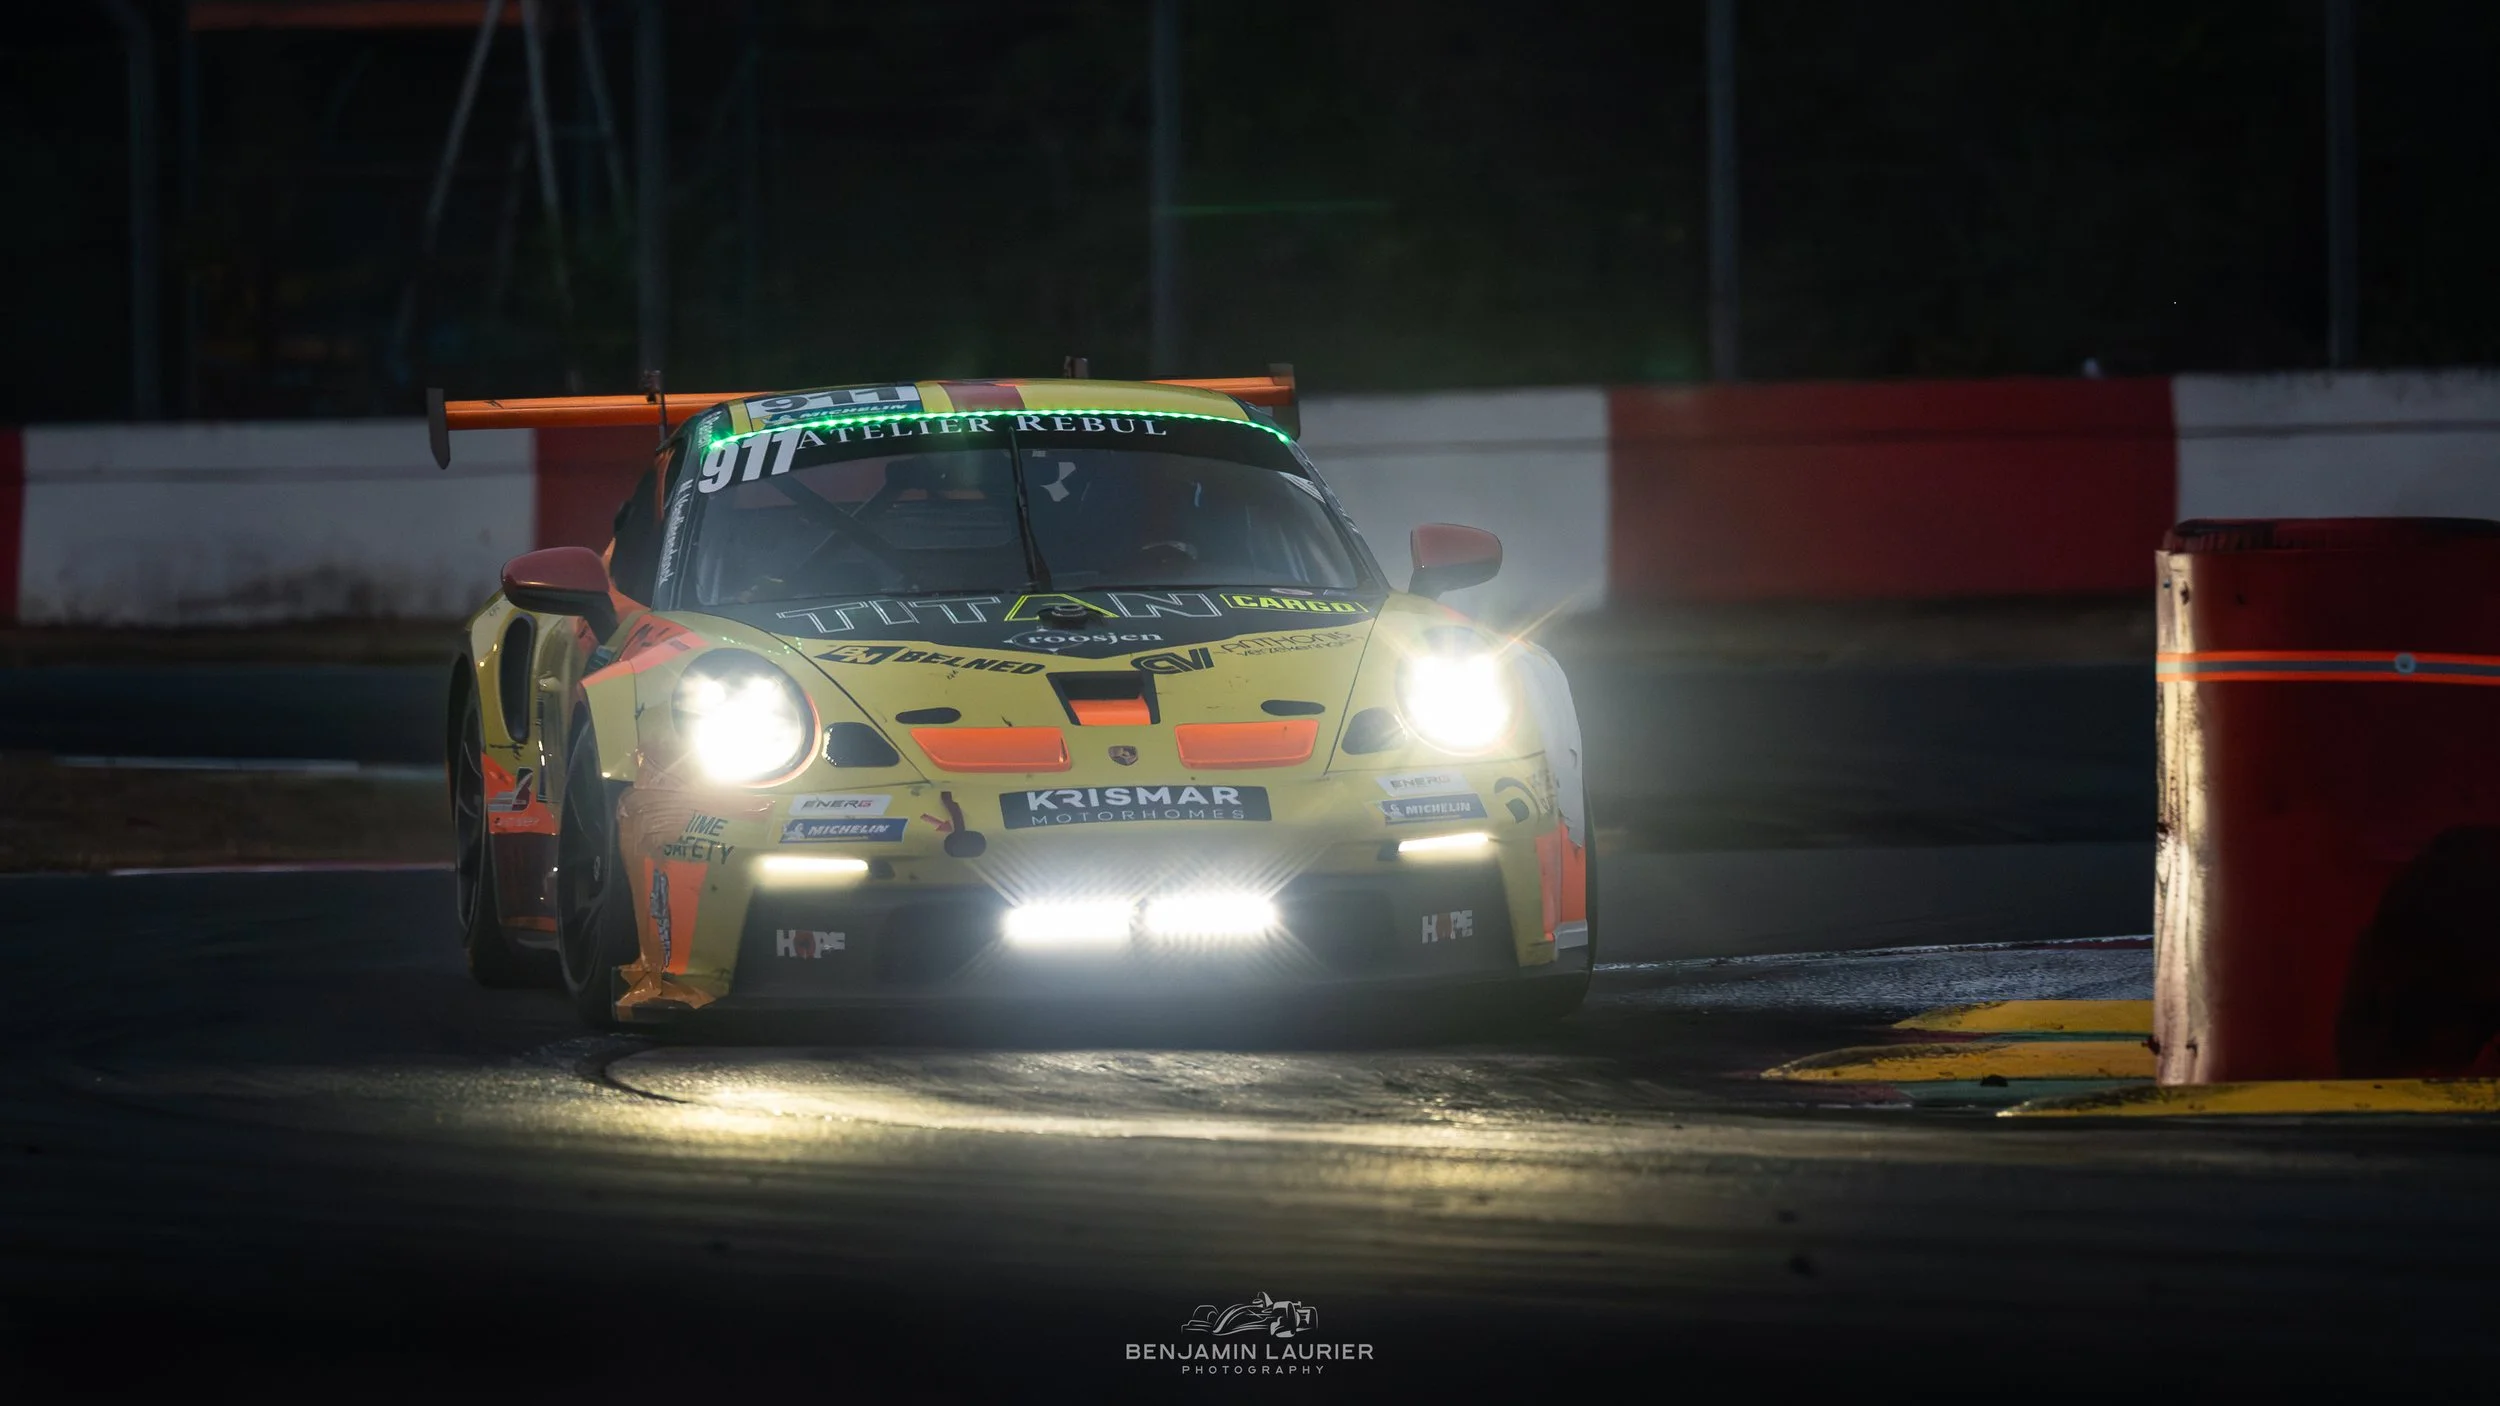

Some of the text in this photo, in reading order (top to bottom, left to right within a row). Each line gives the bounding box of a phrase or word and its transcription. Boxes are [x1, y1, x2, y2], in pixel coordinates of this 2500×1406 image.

[760, 387, 899, 413] 911
[799, 404, 908, 418] MICHELIN
[797, 414, 1167, 450] ATELIER REBUL
[698, 427, 803, 494] 911
[776, 593, 1357, 633] TITAN CARGO
[1028, 632, 1164, 644] roosjen
[893, 651, 1046, 674] BELNED
[1026, 786, 1243, 811] KRISMAR
[1405, 802, 1471, 815] MICHELIN
[1032, 809, 1244, 826] MOTORHOMES
[808, 824, 889, 836] MICHELIN
